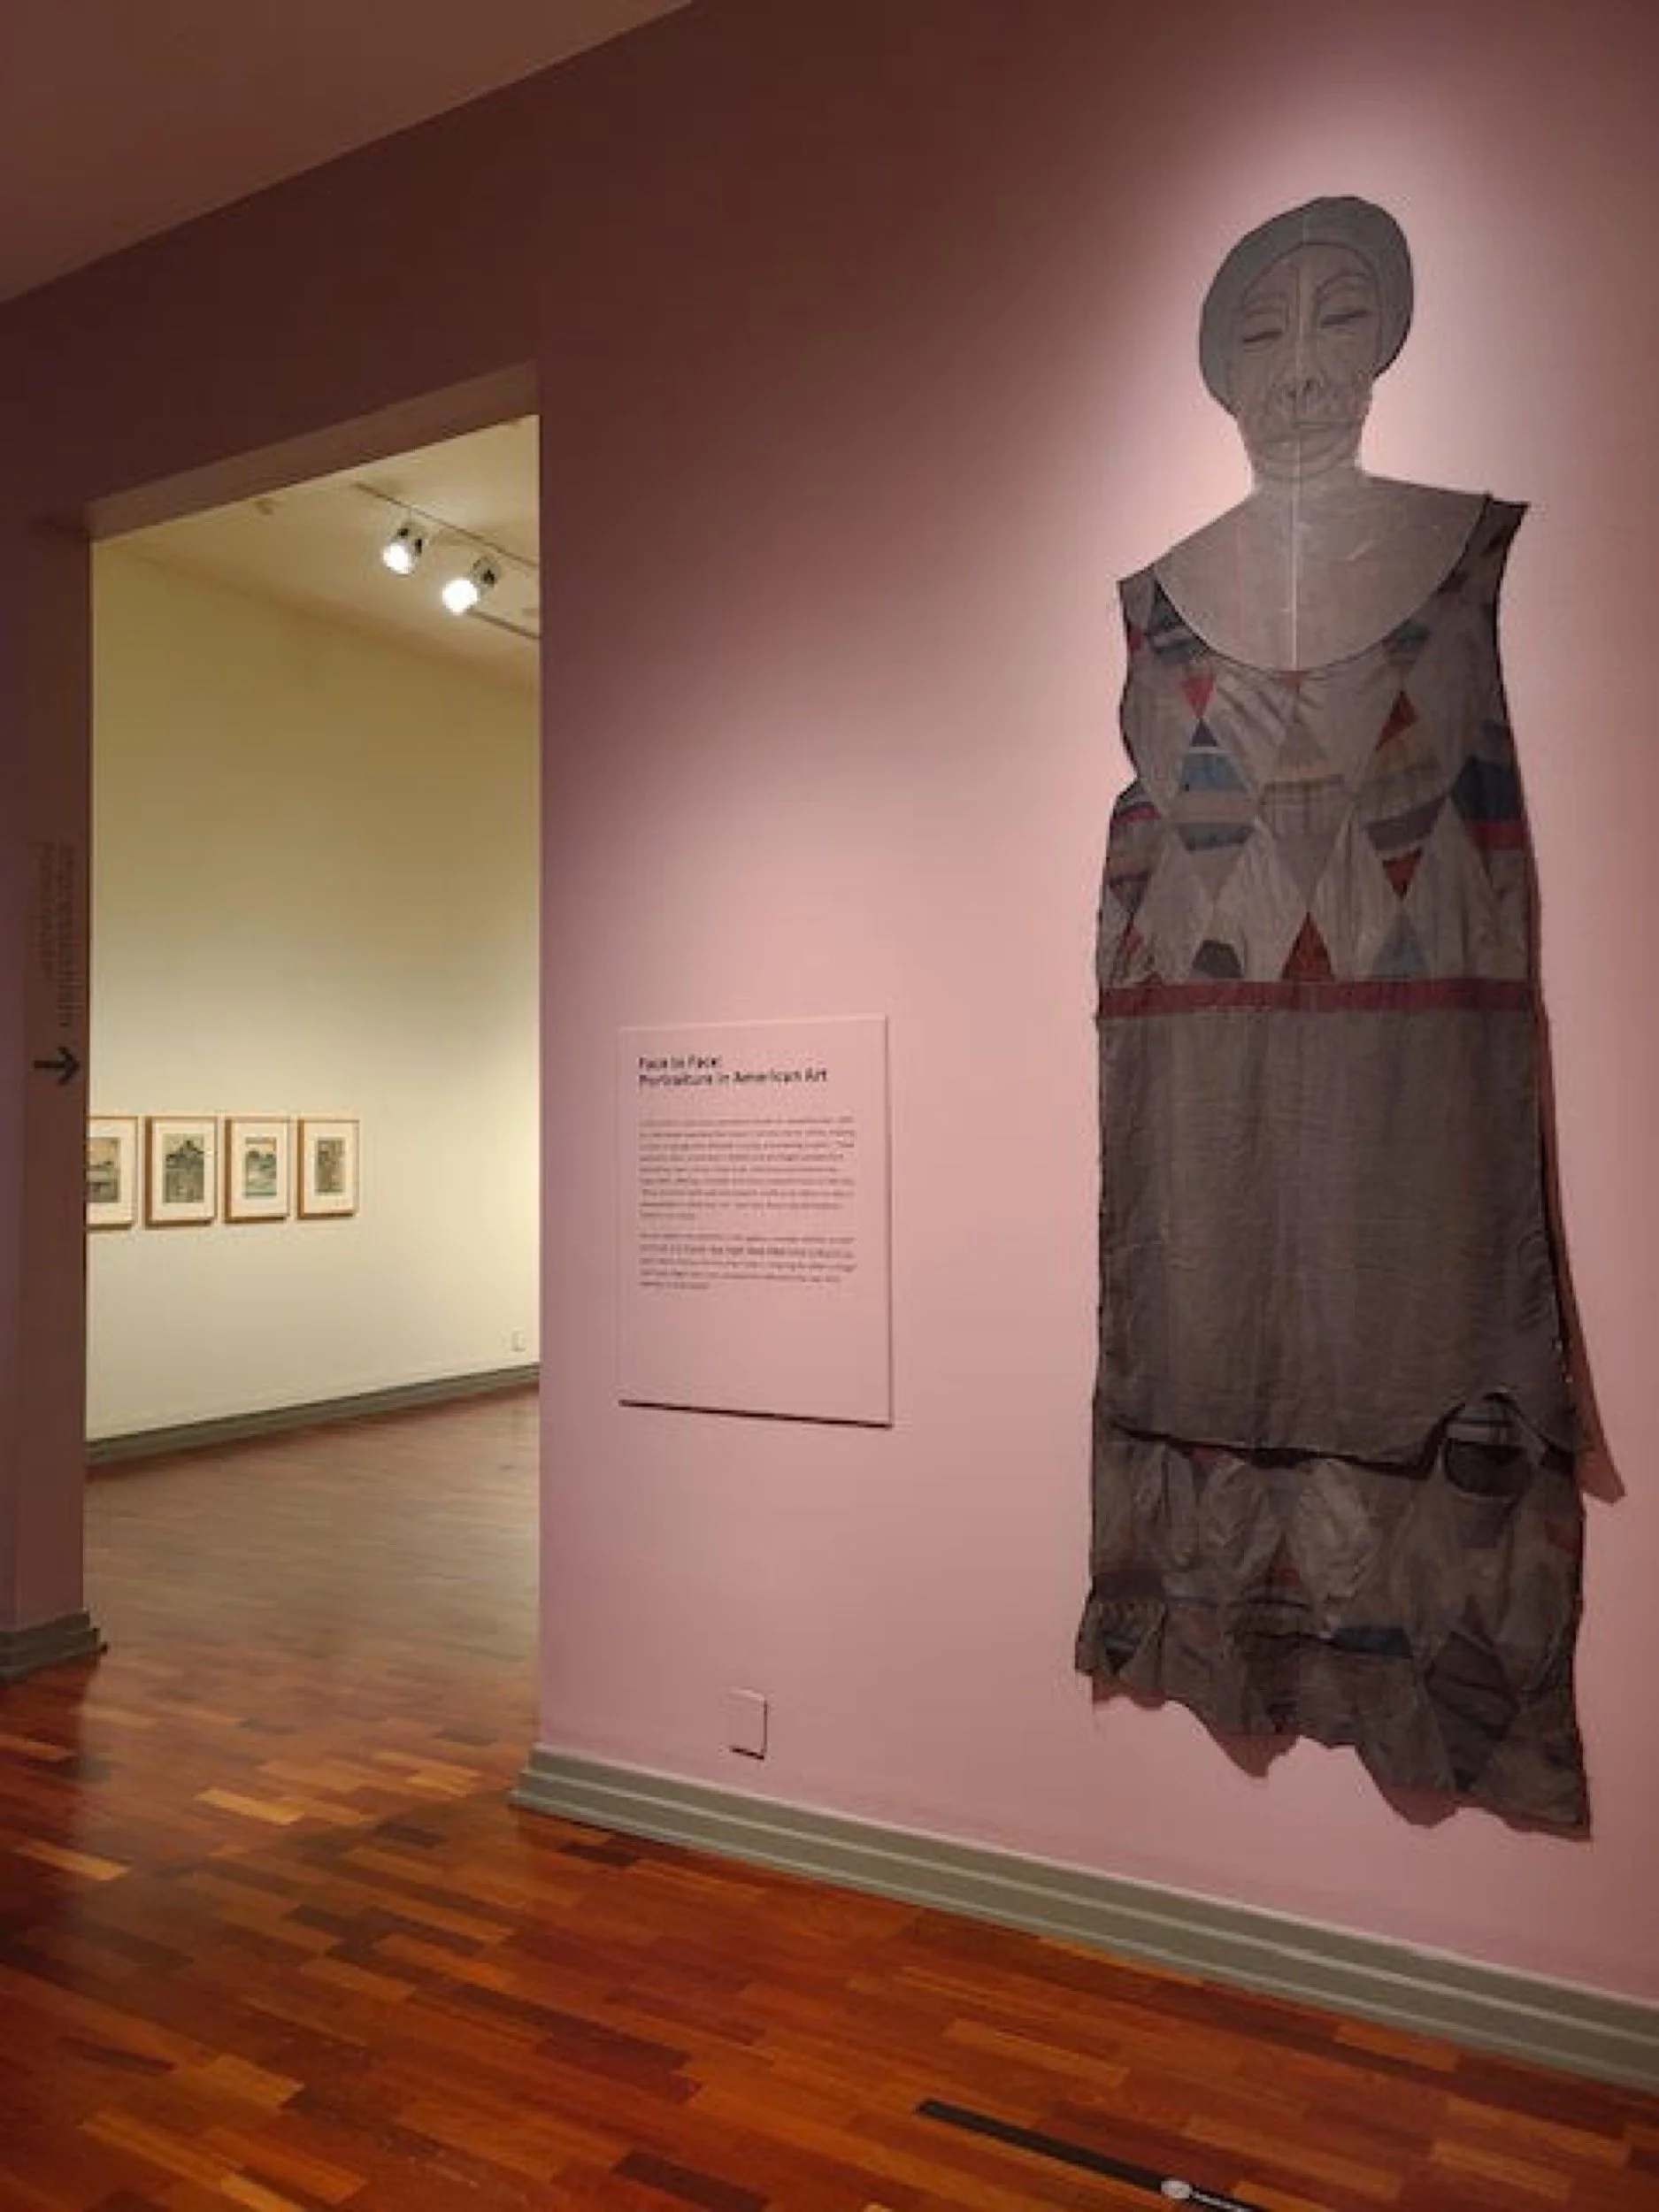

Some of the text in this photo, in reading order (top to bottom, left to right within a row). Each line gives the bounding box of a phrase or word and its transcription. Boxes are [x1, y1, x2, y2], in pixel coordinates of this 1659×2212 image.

[638, 1068, 827, 1086] Portraiture in American Art
